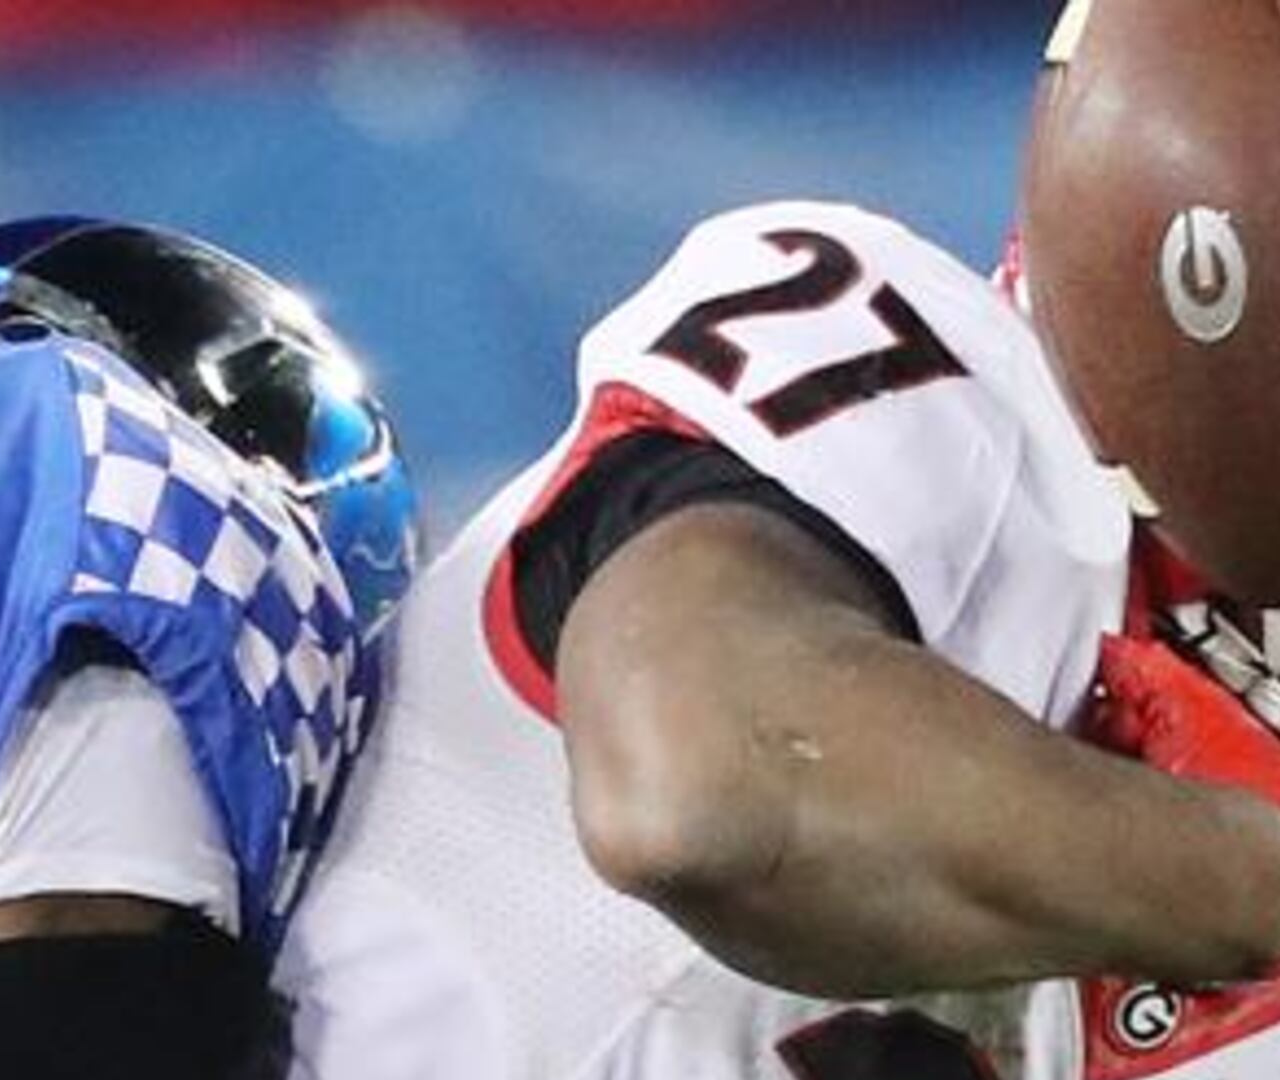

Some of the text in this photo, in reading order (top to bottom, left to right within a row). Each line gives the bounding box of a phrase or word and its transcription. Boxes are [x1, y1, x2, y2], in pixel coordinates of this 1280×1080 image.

[644, 228, 970, 439] 27
[1160, 205, 1247, 342] G
[1116, 984, 1180, 1048] G
